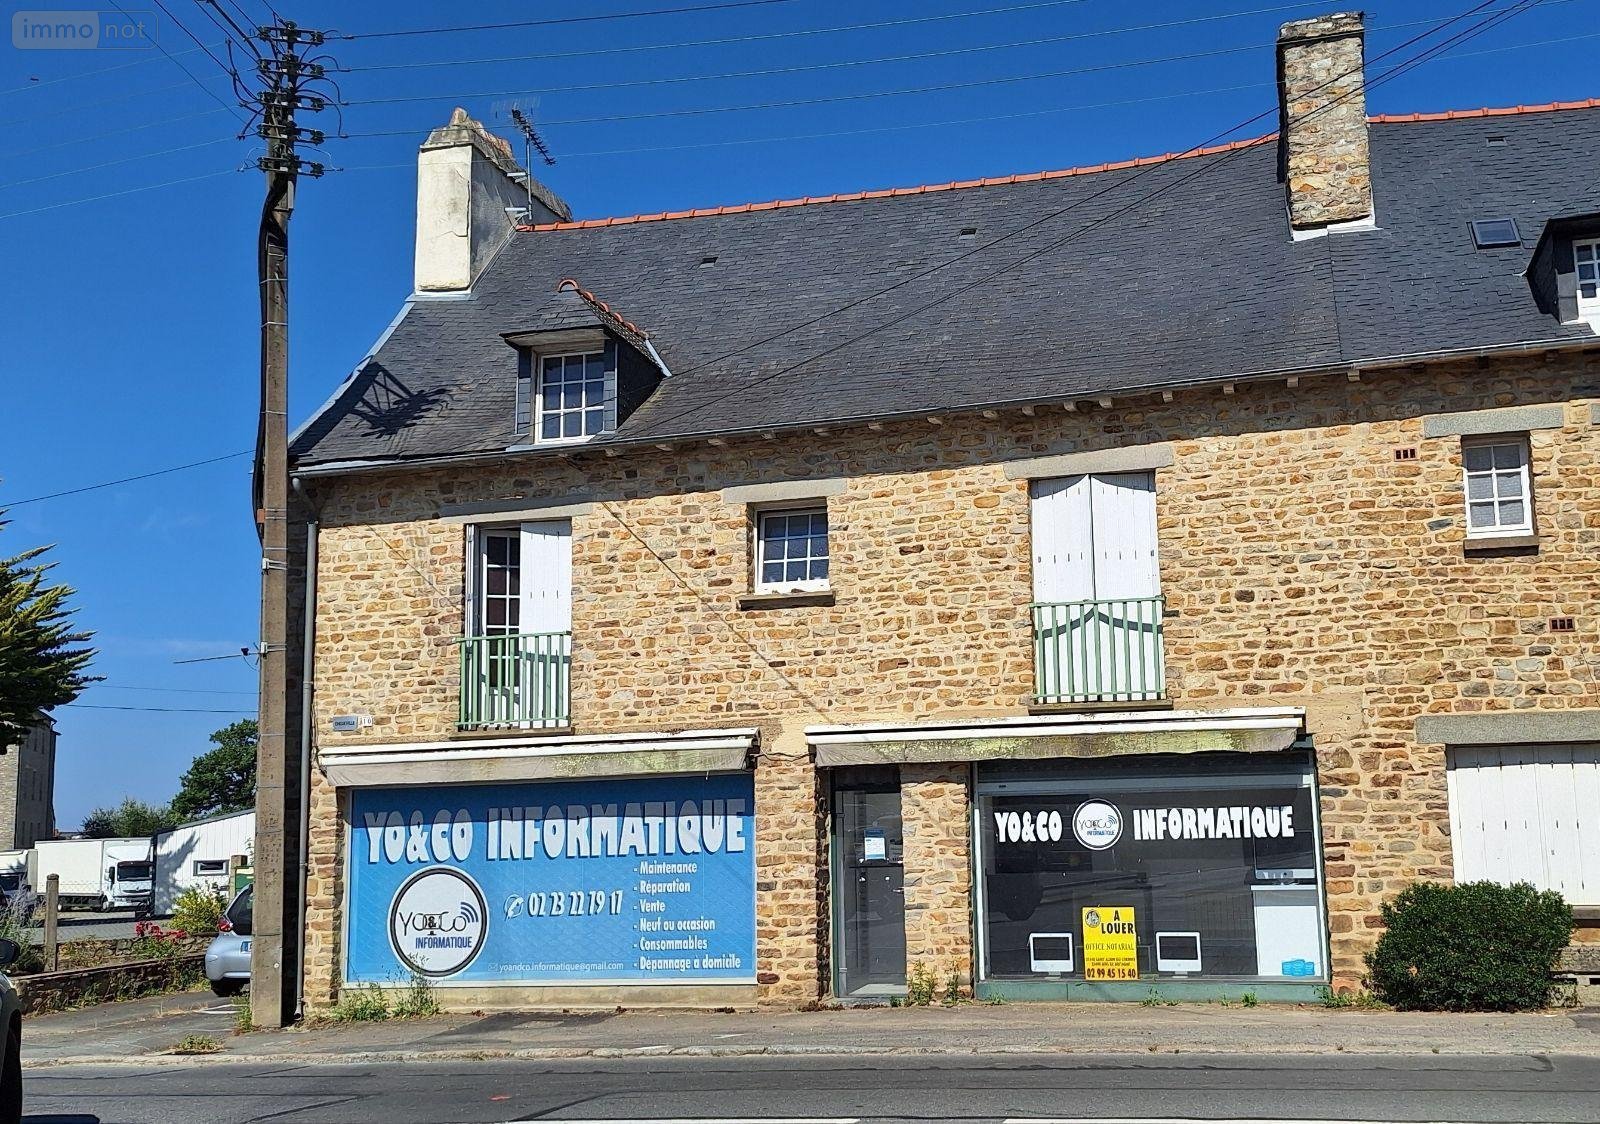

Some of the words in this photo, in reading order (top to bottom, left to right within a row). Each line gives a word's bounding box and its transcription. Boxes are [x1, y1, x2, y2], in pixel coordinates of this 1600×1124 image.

[993, 810, 1063, 843] YO&CO
[1133, 805, 1295, 841] INFORMATIQUE
[364, 808, 474, 864] YO&CO
[487, 799, 746, 860] INFORMATIQUE
[639, 860, 698, 875] Maintenance
[639, 878, 691, 896] Réparation
[527, 891, 546, 917] 02
[549, 890, 566, 917] 23
[568, 890, 585, 916] 22
[609, 889, 624, 916] 17
[639, 899, 666, 913] Vente
[1113, 909, 1120, 922] A
[639, 917, 662, 932] Neuf
[663, 920, 675, 931] ou
[677, 916, 716, 931] occasion
[1101, 922, 1135, 934] LOUER
[415, 936, 473, 950] INFORMATIQUE
[639, 935, 708, 951] Consommables
[1085, 942, 1104, 951] OFFICE
[1106, 942, 1135, 951] NOTARIAL
[500, 961, 624, 974] yoandco.informatique@gmail.com
[639, 956, 691, 972] Dépannage
[702, 953, 741, 969] domicile
[1086, 967, 1095, 978] 02
[1097, 967, 1106, 978] 99
[1117, 968, 1126, 978] 15
